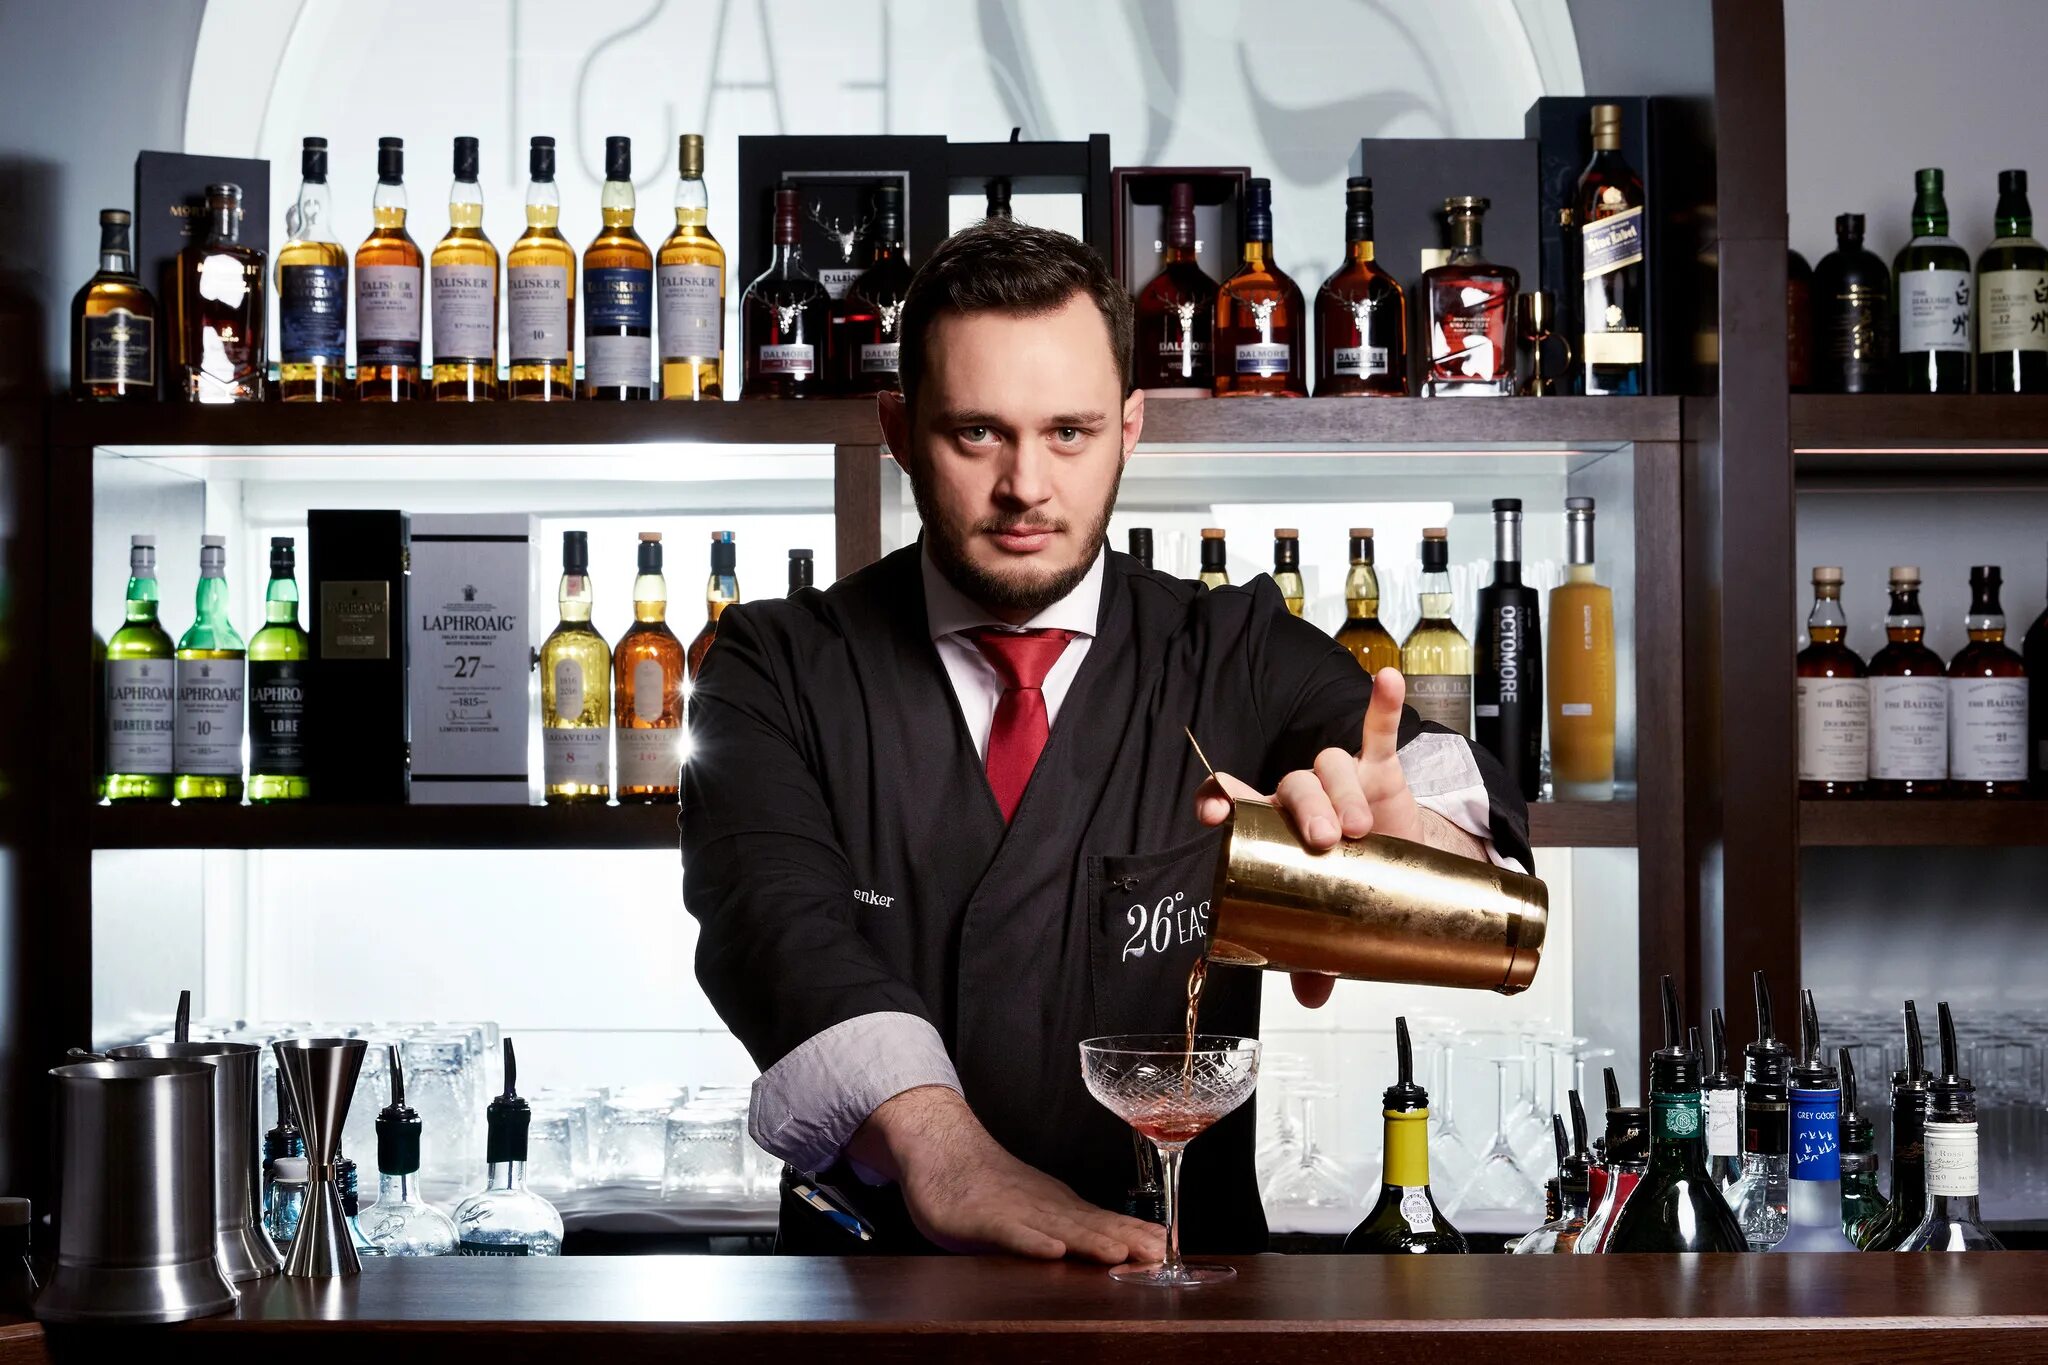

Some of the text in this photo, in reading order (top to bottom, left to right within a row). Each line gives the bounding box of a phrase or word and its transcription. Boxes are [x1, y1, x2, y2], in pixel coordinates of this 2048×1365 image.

[434, 278, 488, 288] TALISKER
[661, 276, 715, 287] TALISKER
[533, 330, 545, 340] 10
[864, 350, 899, 358] DALMO
[1338, 353, 1383, 361] DALRE
[423, 615, 514, 631] LAPHROAIG
[1500, 605, 1518, 704] OCTOMORE
[454, 655, 481, 678] 27
[459, 697, 479, 706] 1815
[113, 719, 152, 732] QUARTER
[197, 720, 211, 735] 10
[271, 719, 299, 732] LORE
[566, 752, 576, 763] 8
[853, 889, 895, 908] enker
[1177, 900, 1211, 945] EAS
[1797, 1111, 1814, 1120] GREY
